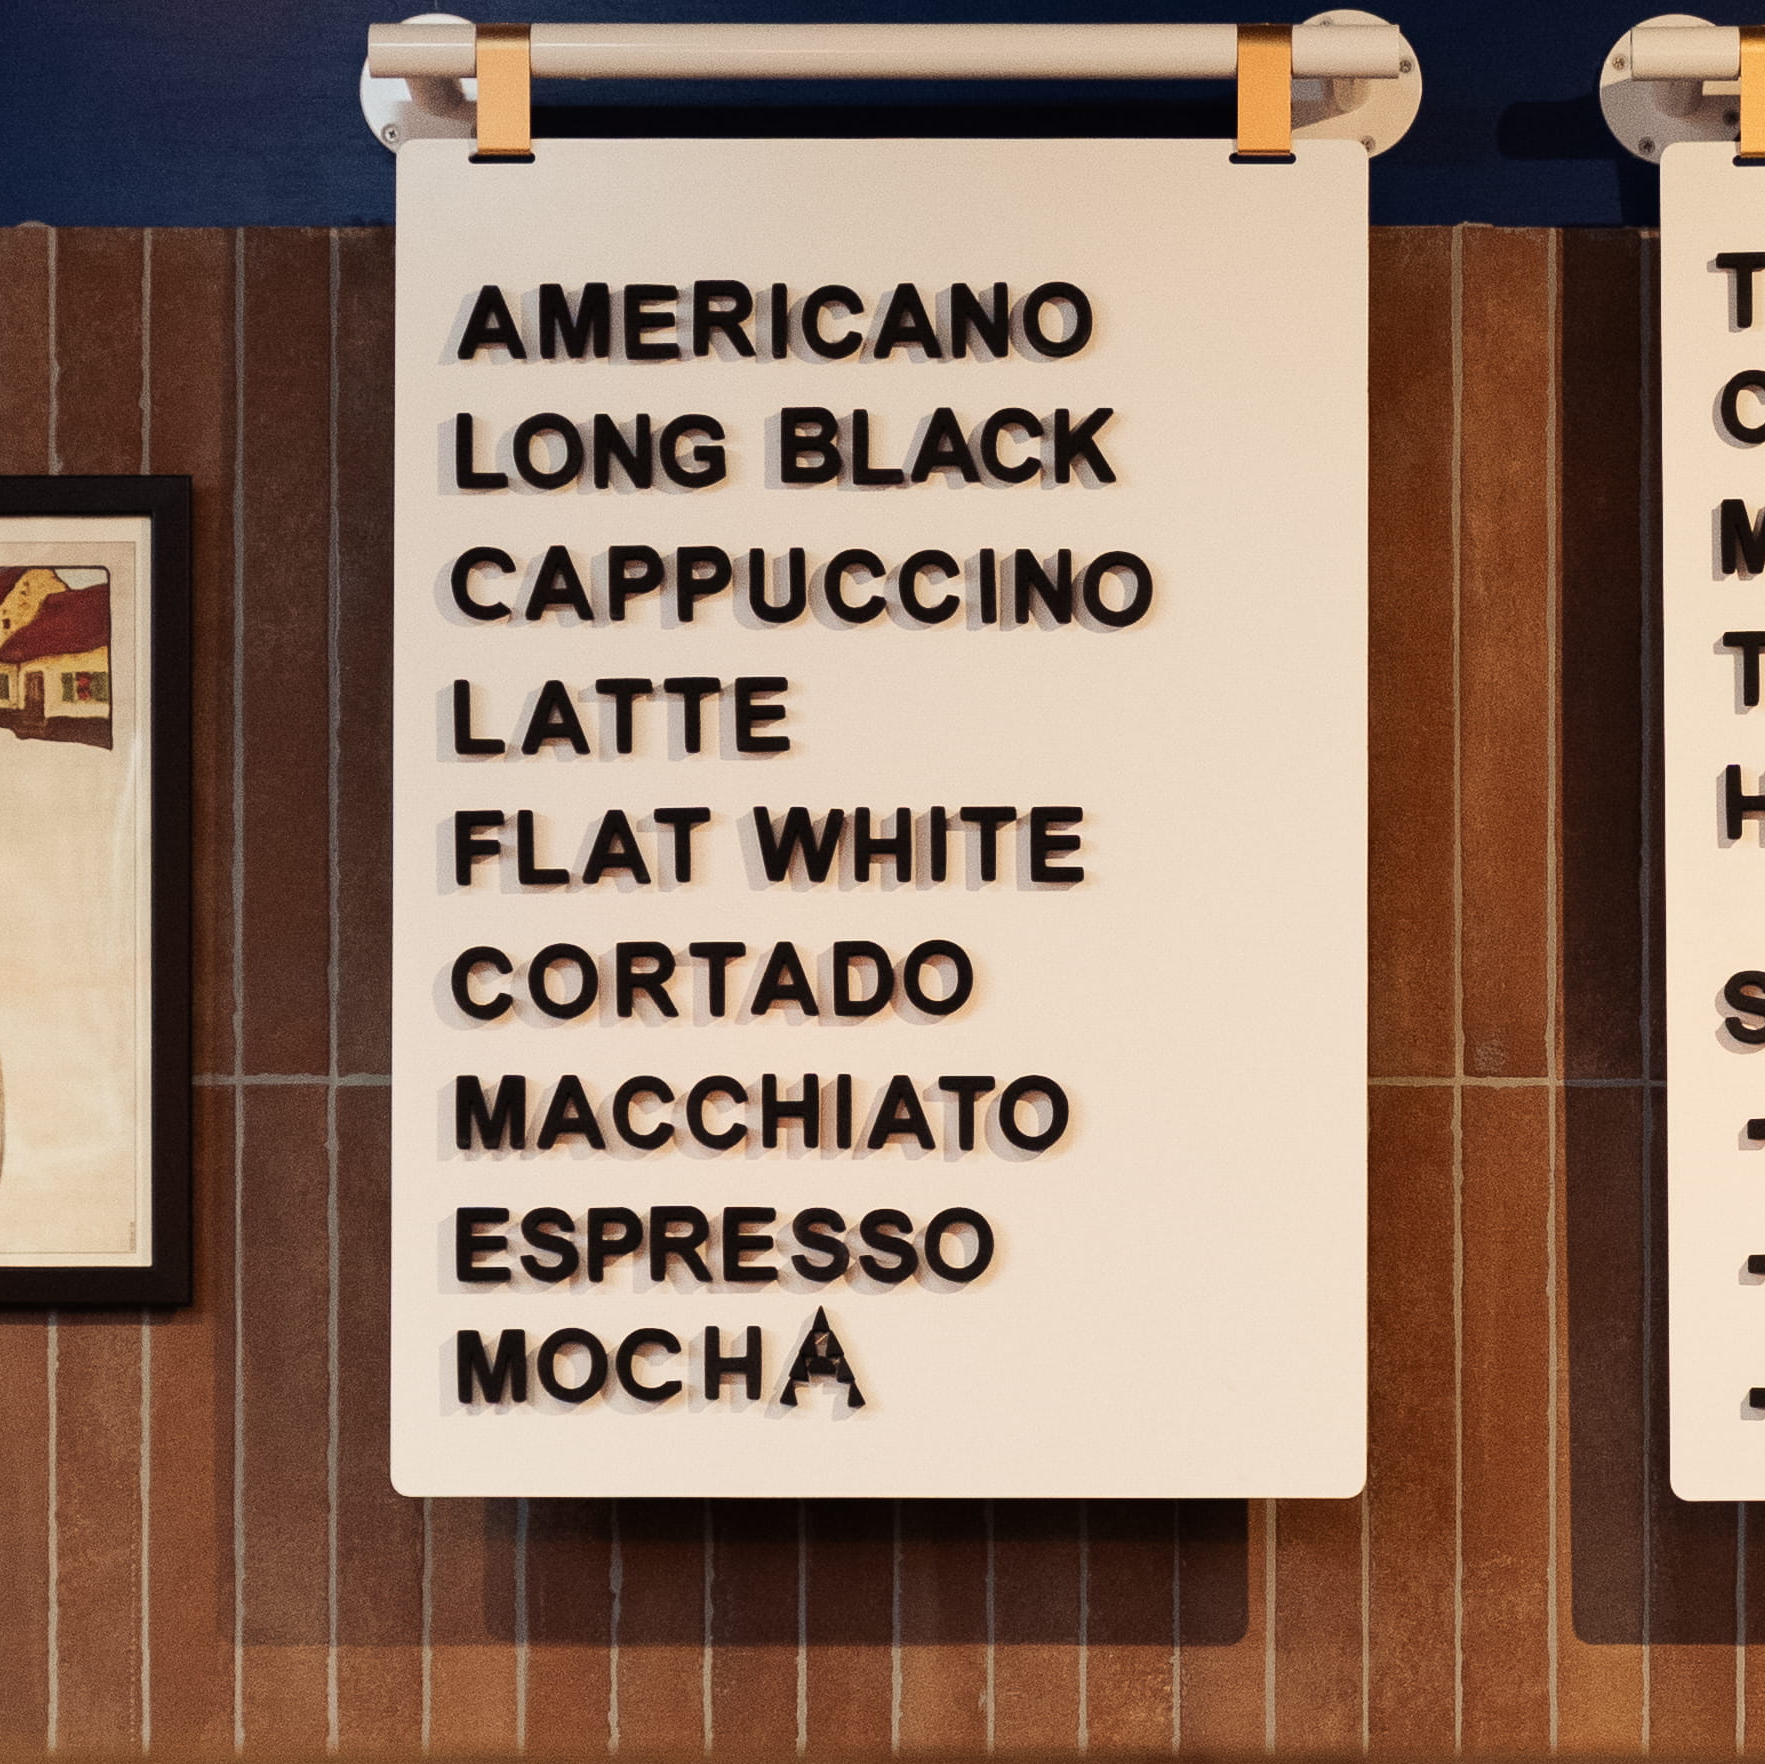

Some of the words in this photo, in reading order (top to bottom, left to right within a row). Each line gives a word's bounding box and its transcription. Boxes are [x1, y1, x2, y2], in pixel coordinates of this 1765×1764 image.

[458, 280, 1092, 360] AMERICANO
[456, 413, 726, 490] LONG
[781, 407, 1116, 485] BLACK
[451, 546, 1152, 627] CAPPUCCINO
[454, 677, 790, 755] LATTE
[456, 808, 710, 885] FLAT
[754, 807, 1084, 882] WHITE
[452, 940, 973, 1020] CORTADO
[456, 1074, 1068, 1151] MACCHIATO
[457, 1206, 994, 1283] ESPRESSO
[458, 1307, 865, 1407] MOCHA
